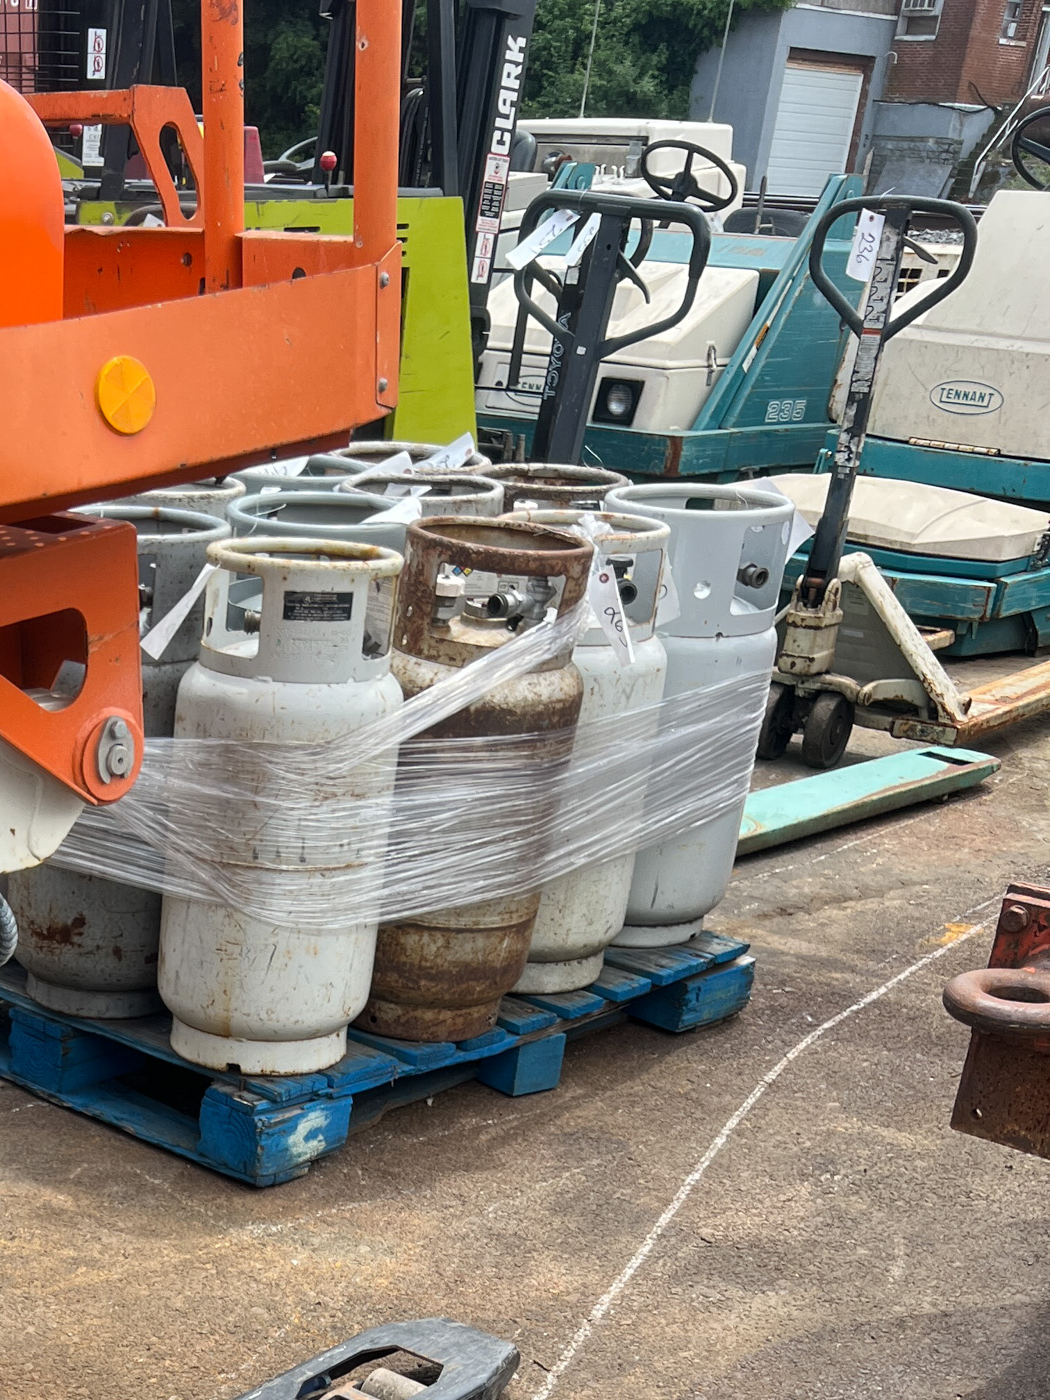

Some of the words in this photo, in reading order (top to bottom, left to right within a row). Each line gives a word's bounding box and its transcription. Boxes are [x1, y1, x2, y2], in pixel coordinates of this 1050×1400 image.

[491, 34, 527, 155] CLARK
[856, 232, 876, 264] 236
[543, 312, 572, 400] TOYOA
[765, 400, 807, 422] 235
[939, 387, 995, 408] TENNANT
